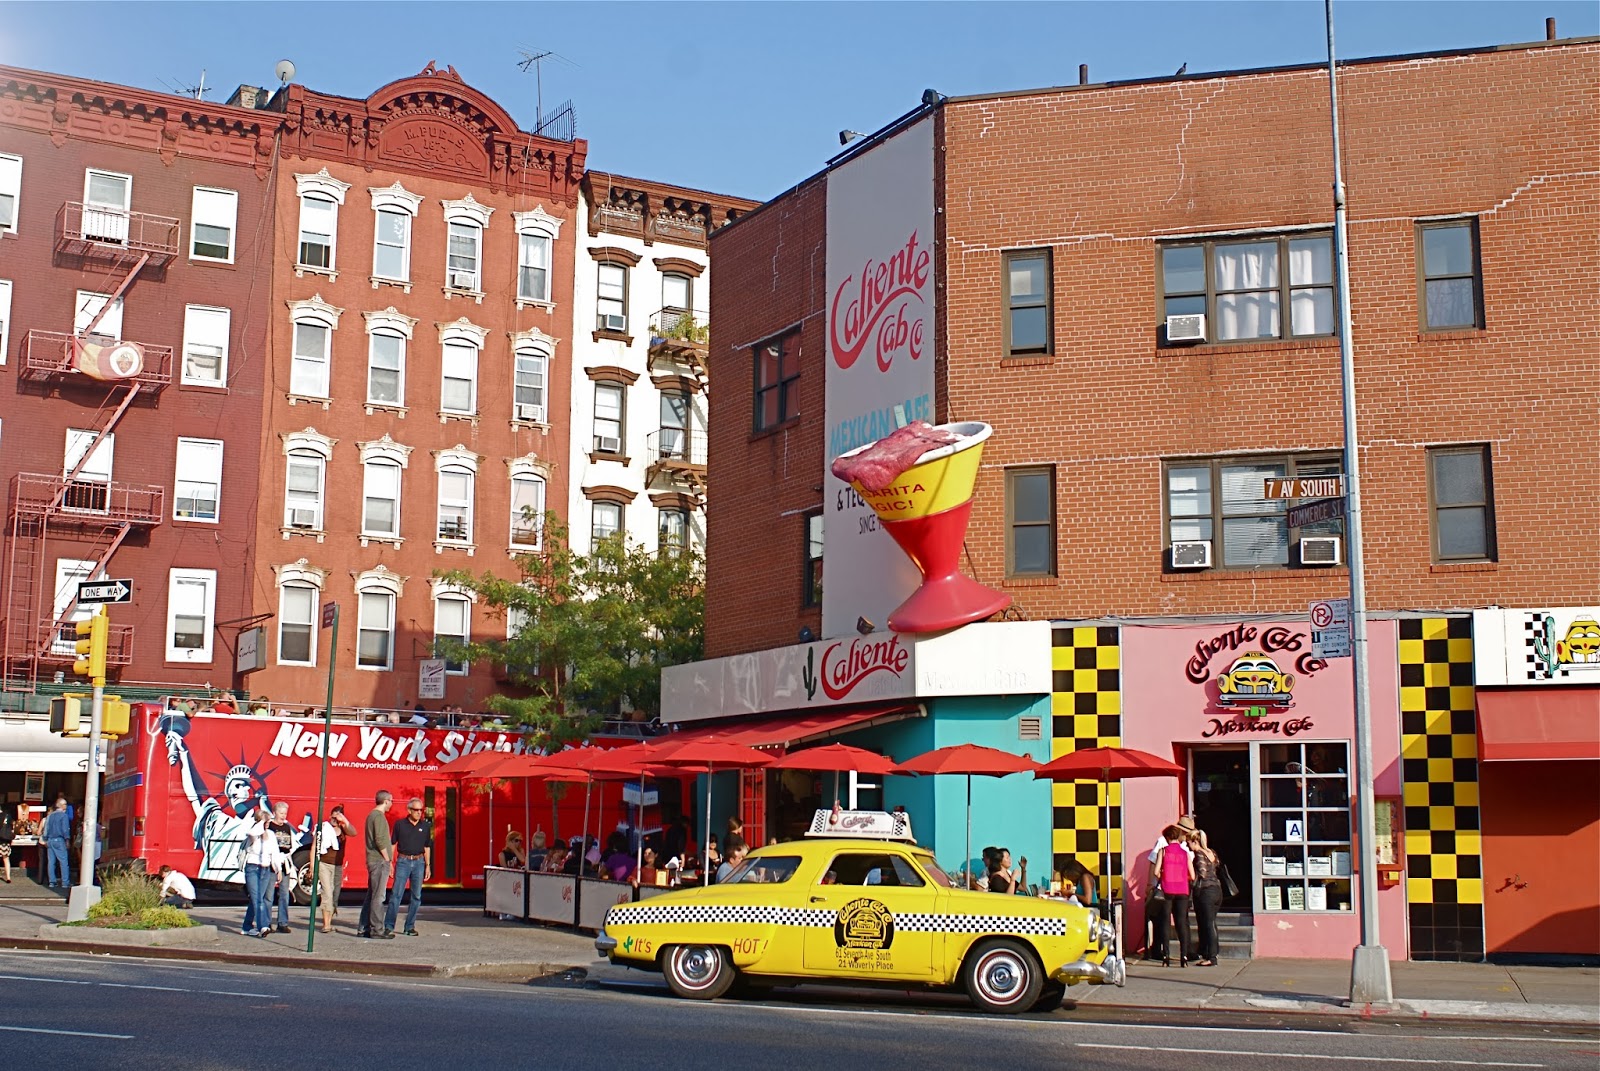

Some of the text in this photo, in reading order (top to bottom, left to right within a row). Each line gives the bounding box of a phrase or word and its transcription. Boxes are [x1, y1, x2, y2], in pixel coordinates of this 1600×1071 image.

[831, 228, 930, 369] Caliente
[876, 303, 908, 372] Cab
[829, 408, 890, 459] MEXICAN
[1266, 479, 1336, 498] 7 AV SOUTH
[859, 514, 876, 535] SINCE
[1289, 500, 1341, 528] COMMERCE ST
[85, 586, 124, 597] ONE WAY
[1185, 623, 1258, 684] Caliente
[1260, 626, 1307, 653] Cab
[821, 632, 908, 700] Caliente
[1201, 716, 1314, 738] Mexican Cafe
[269, 722, 348, 759] New
[357, 726, 431, 764] York
[331, 760, 439, 772] www.newyorksightseeing.com
[1289, 823, 1300, 836] A
[634, 938, 652, 953] It's
[865, 949, 874, 959] Ave
[876, 950, 891, 960] South
[838, 959, 894, 973] 21 Waverly Place
